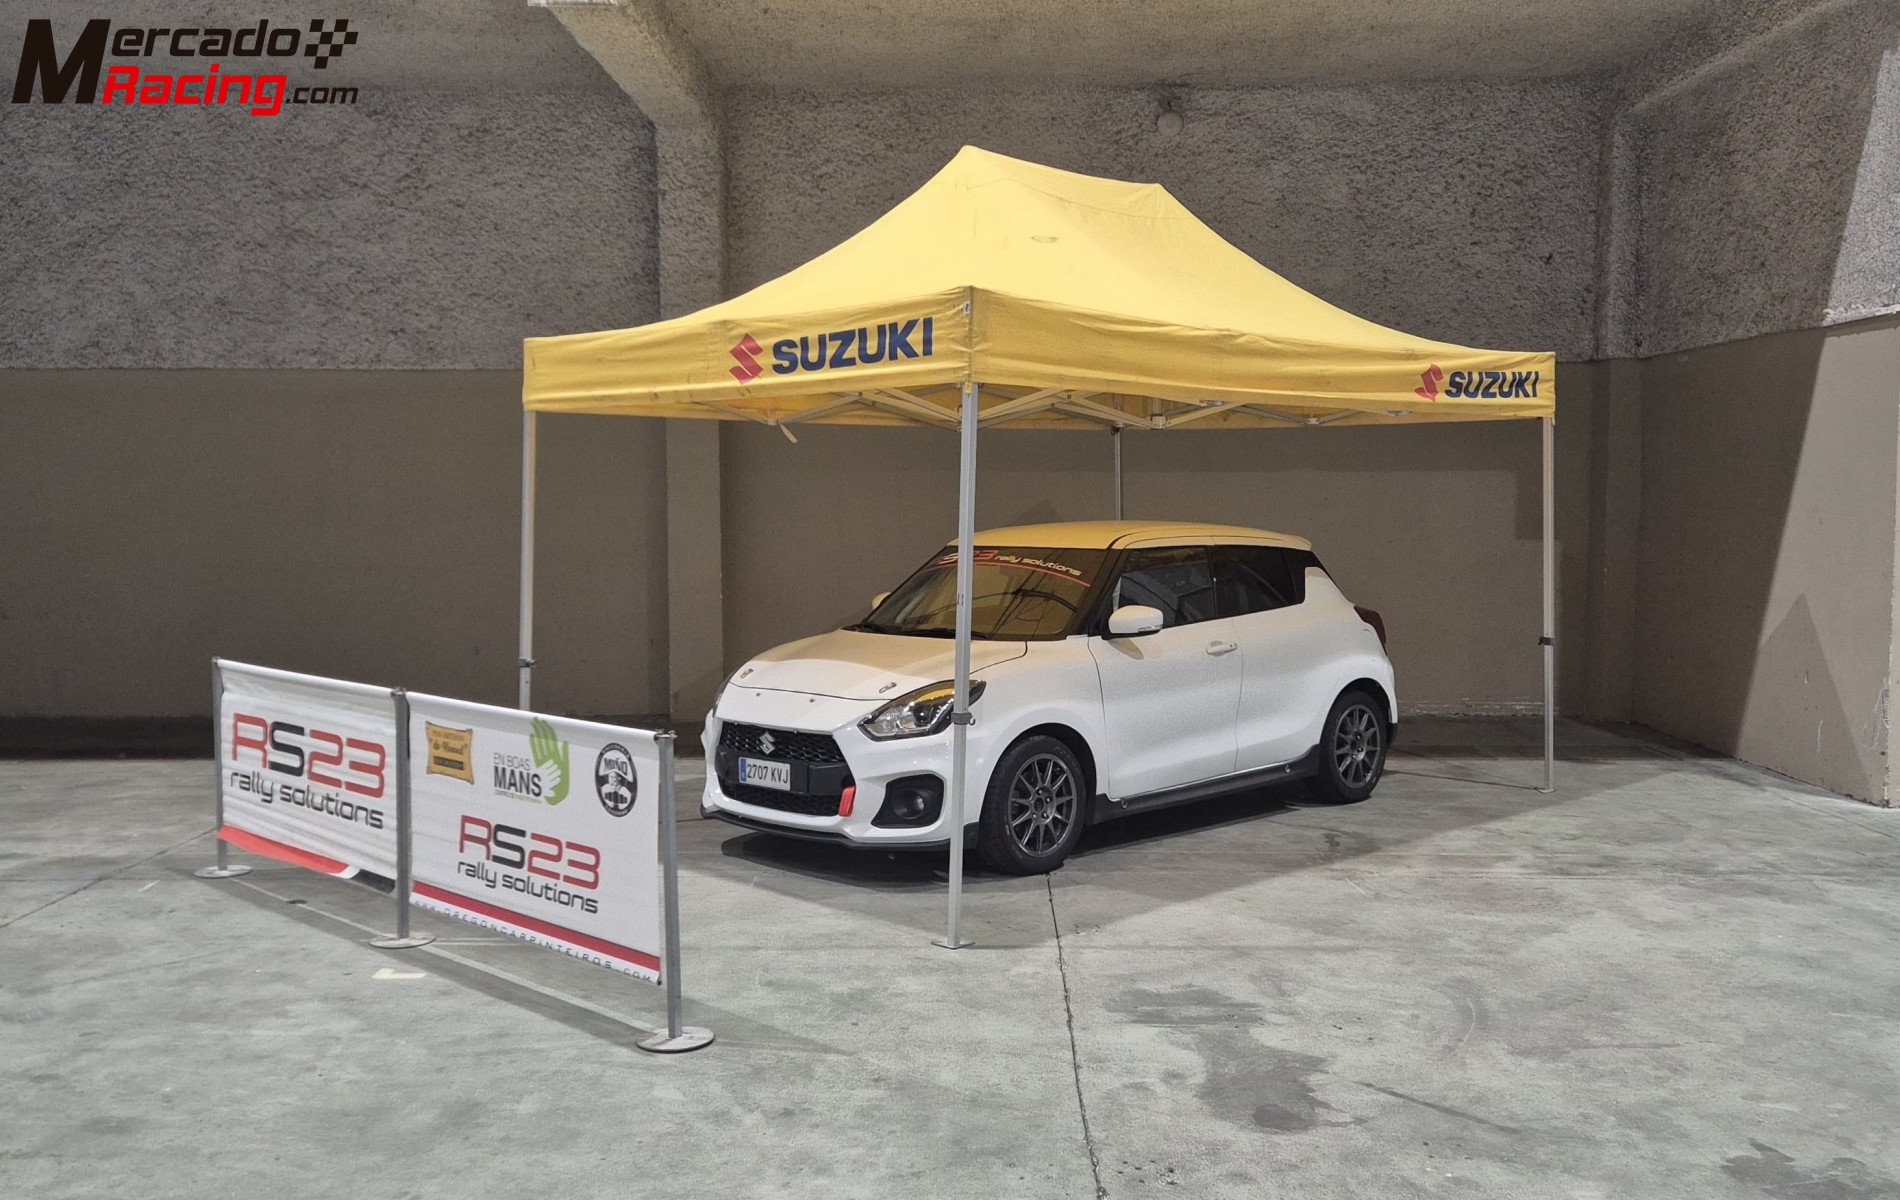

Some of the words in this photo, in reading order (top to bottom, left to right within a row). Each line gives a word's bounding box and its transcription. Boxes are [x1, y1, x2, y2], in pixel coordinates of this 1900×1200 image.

[772, 316, 933, 375] SUZUKI
[1444, 371, 1540, 399] SUZUKI
[994, 555, 1022, 564] rally
[1022, 557, 1082, 577] solutions
[231, 713, 387, 799] RS23
[493, 765, 542, 797] MANS
[746, 763, 769, 780] 2707
[770, 767, 789, 784] KVJ
[230, 771, 274, 804] rally
[280, 784, 384, 829] solutions
[458, 814, 602, 891] RS23
[457, 859, 497, 889] rally
[501, 873, 599, 914] solutions
